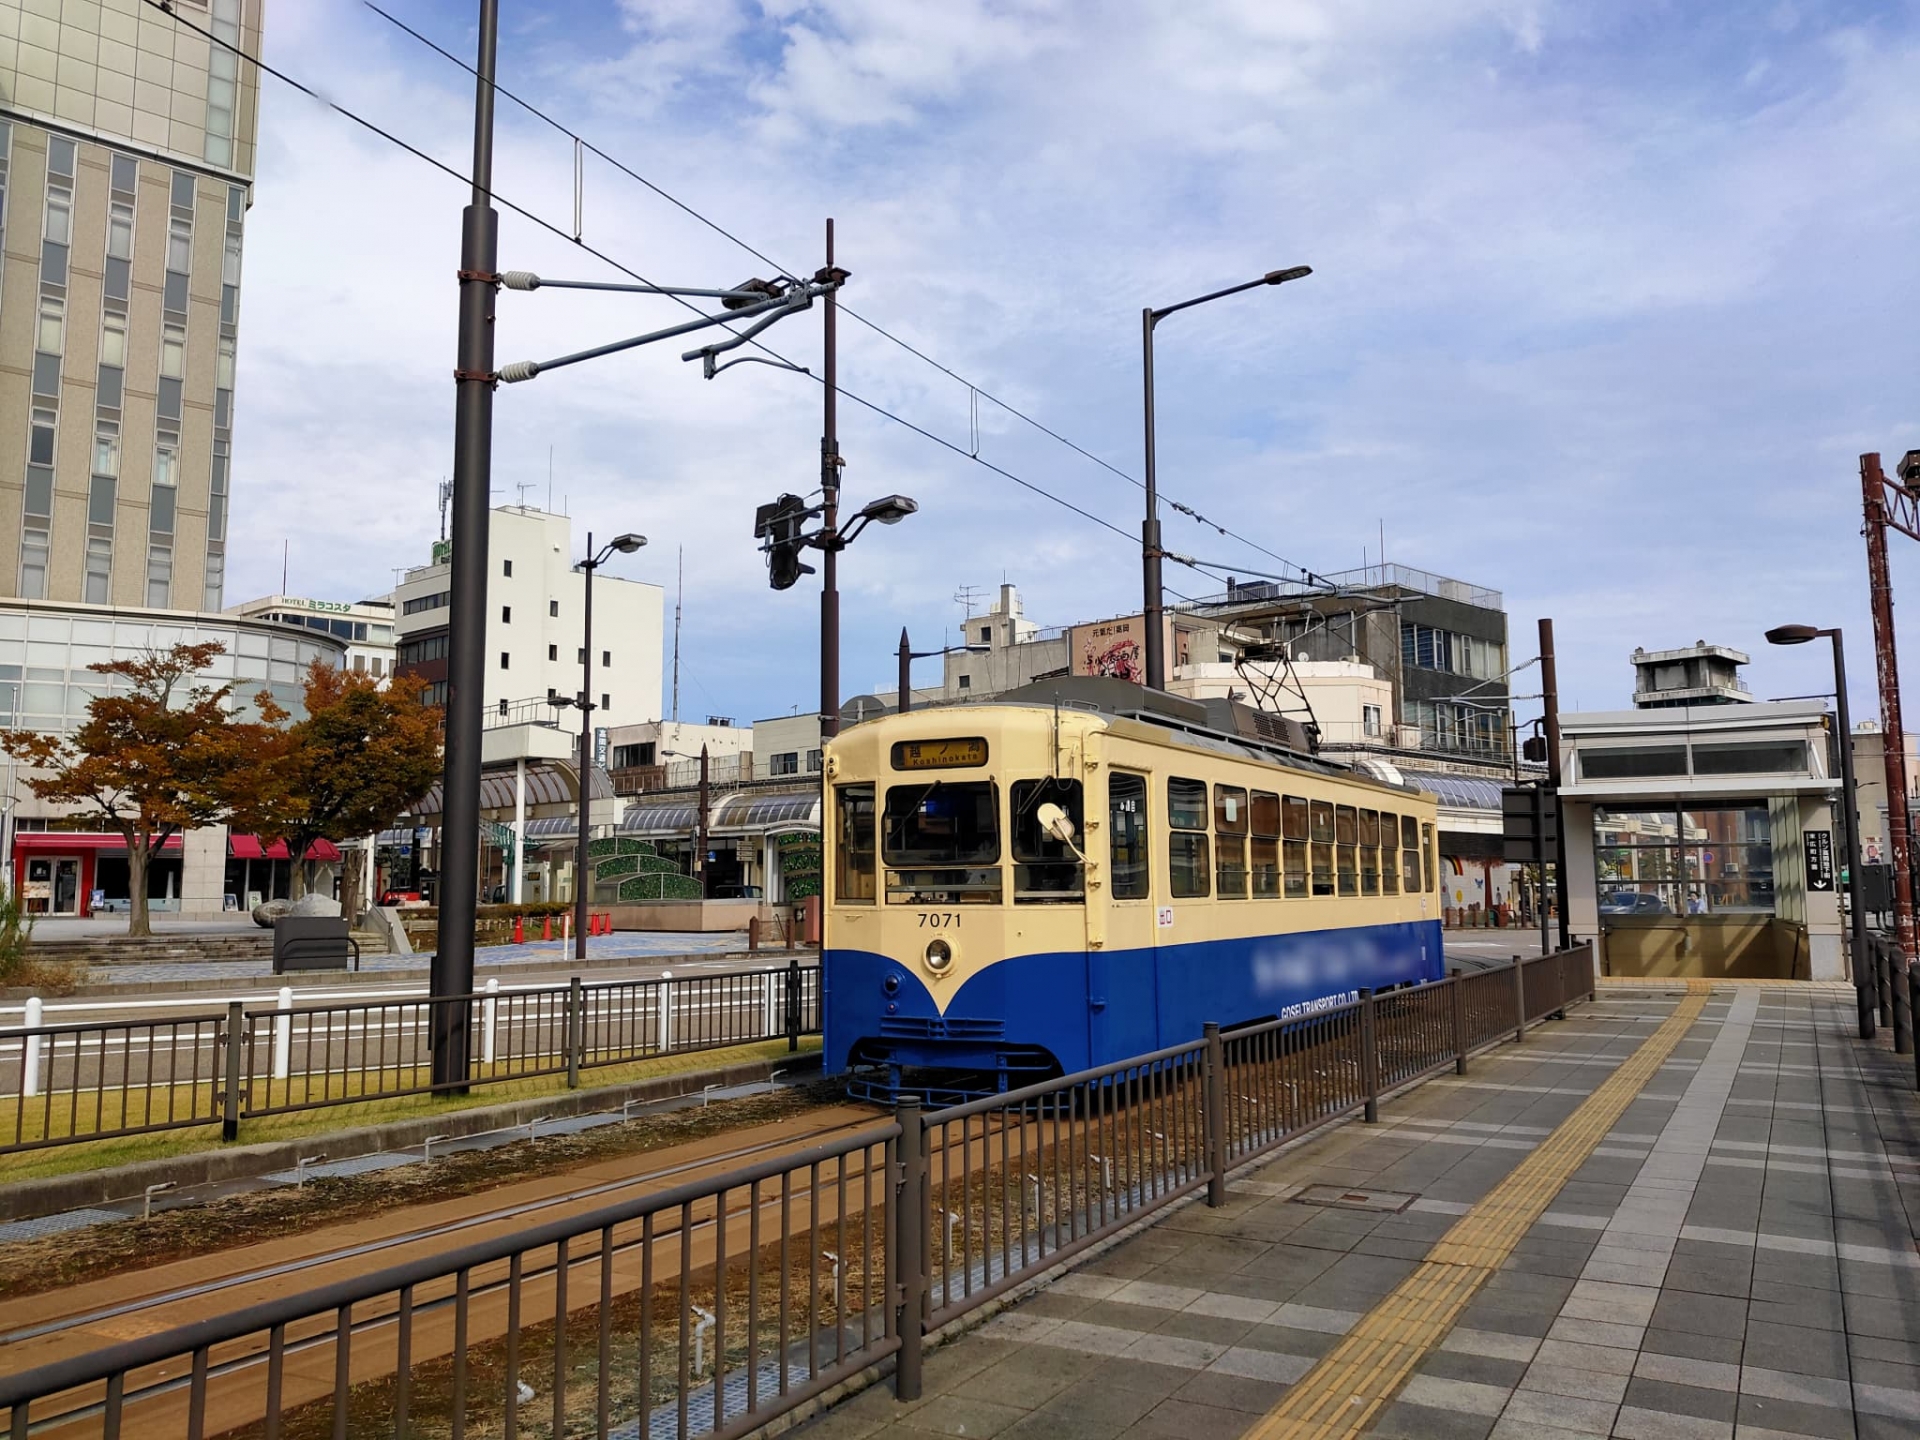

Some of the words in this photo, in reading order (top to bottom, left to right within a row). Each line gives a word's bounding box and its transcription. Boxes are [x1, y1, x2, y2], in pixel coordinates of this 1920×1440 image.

[309, 600, 351, 612] ミラコスタ
[913, 753, 978, 766] Koshinokata
[917, 913, 960, 928] 7071
[1302, 994, 1337, 1014] TRANSPORT
